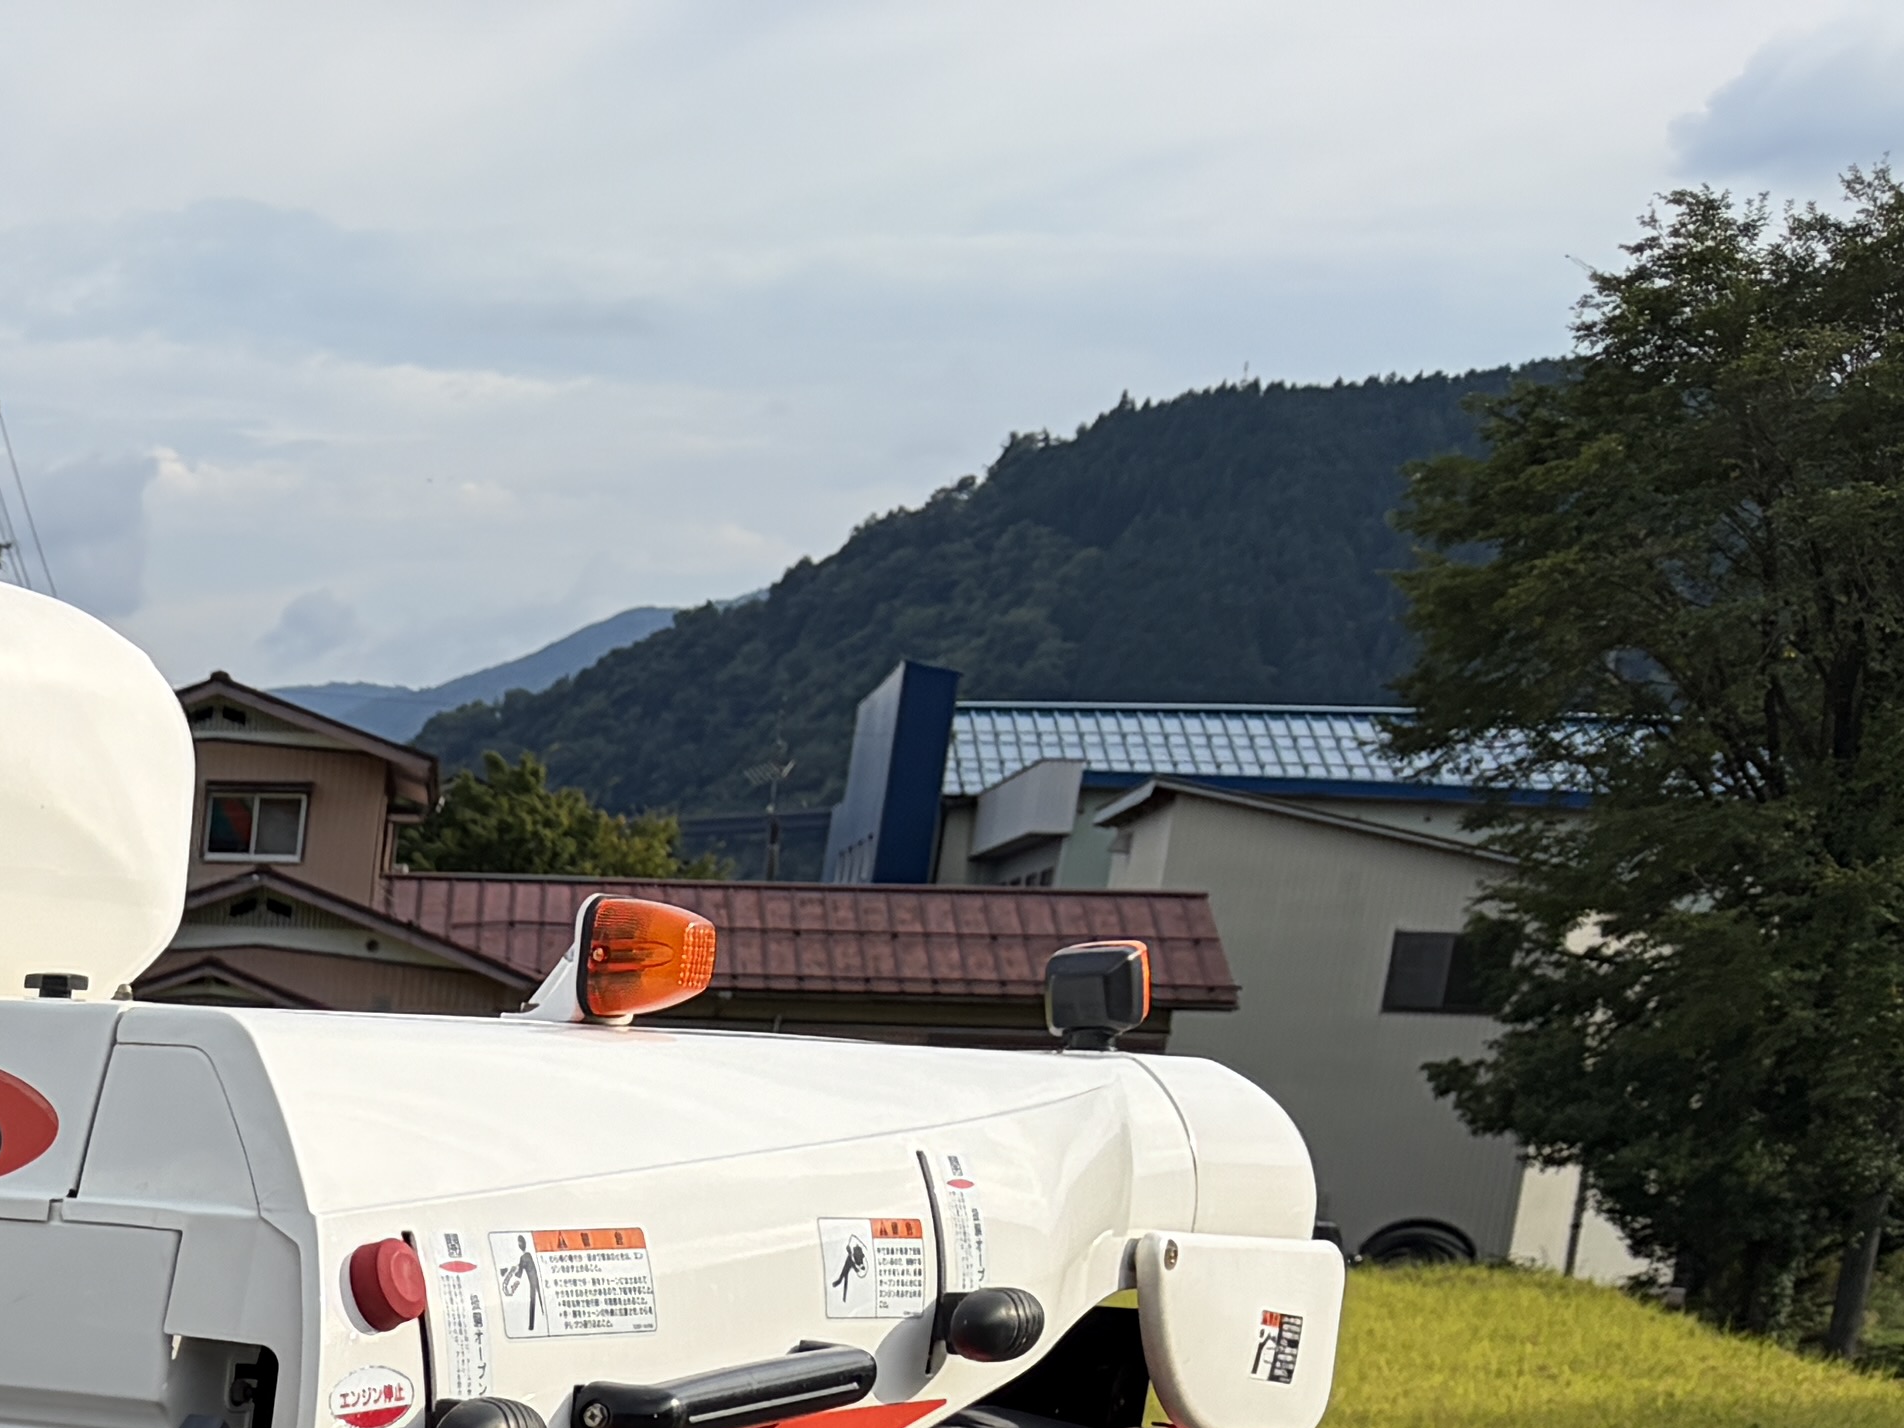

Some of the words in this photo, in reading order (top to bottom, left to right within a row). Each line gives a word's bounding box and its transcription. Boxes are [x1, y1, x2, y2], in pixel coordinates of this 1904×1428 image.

[339, 1382, 406, 1409] エンジン停止
